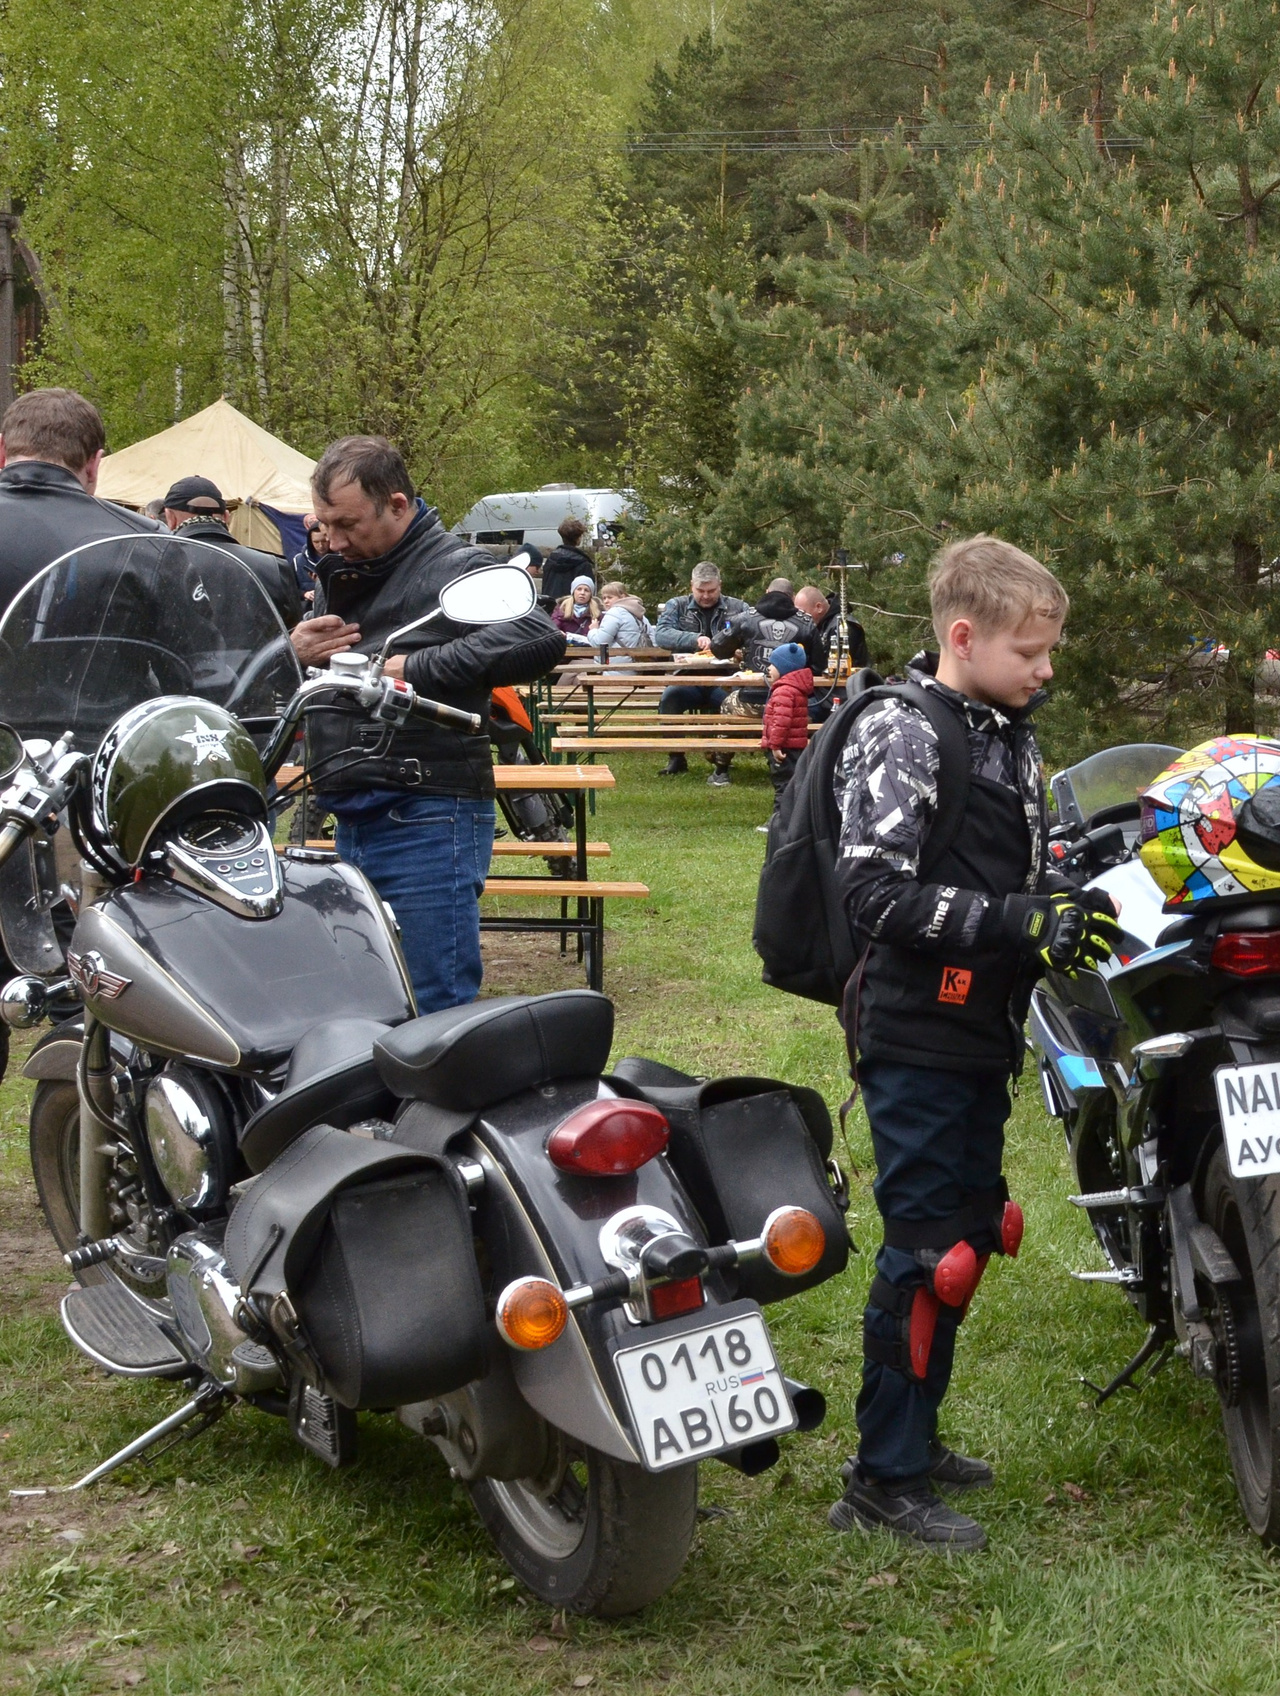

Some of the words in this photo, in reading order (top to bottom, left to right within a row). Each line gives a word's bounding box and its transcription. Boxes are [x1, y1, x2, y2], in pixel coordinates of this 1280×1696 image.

[925, 900, 950, 938] Time
[640, 1328, 752, 1391] 0118
[705, 1375, 740, 1396] RUS
[727, 1387, 780, 1433] 60
